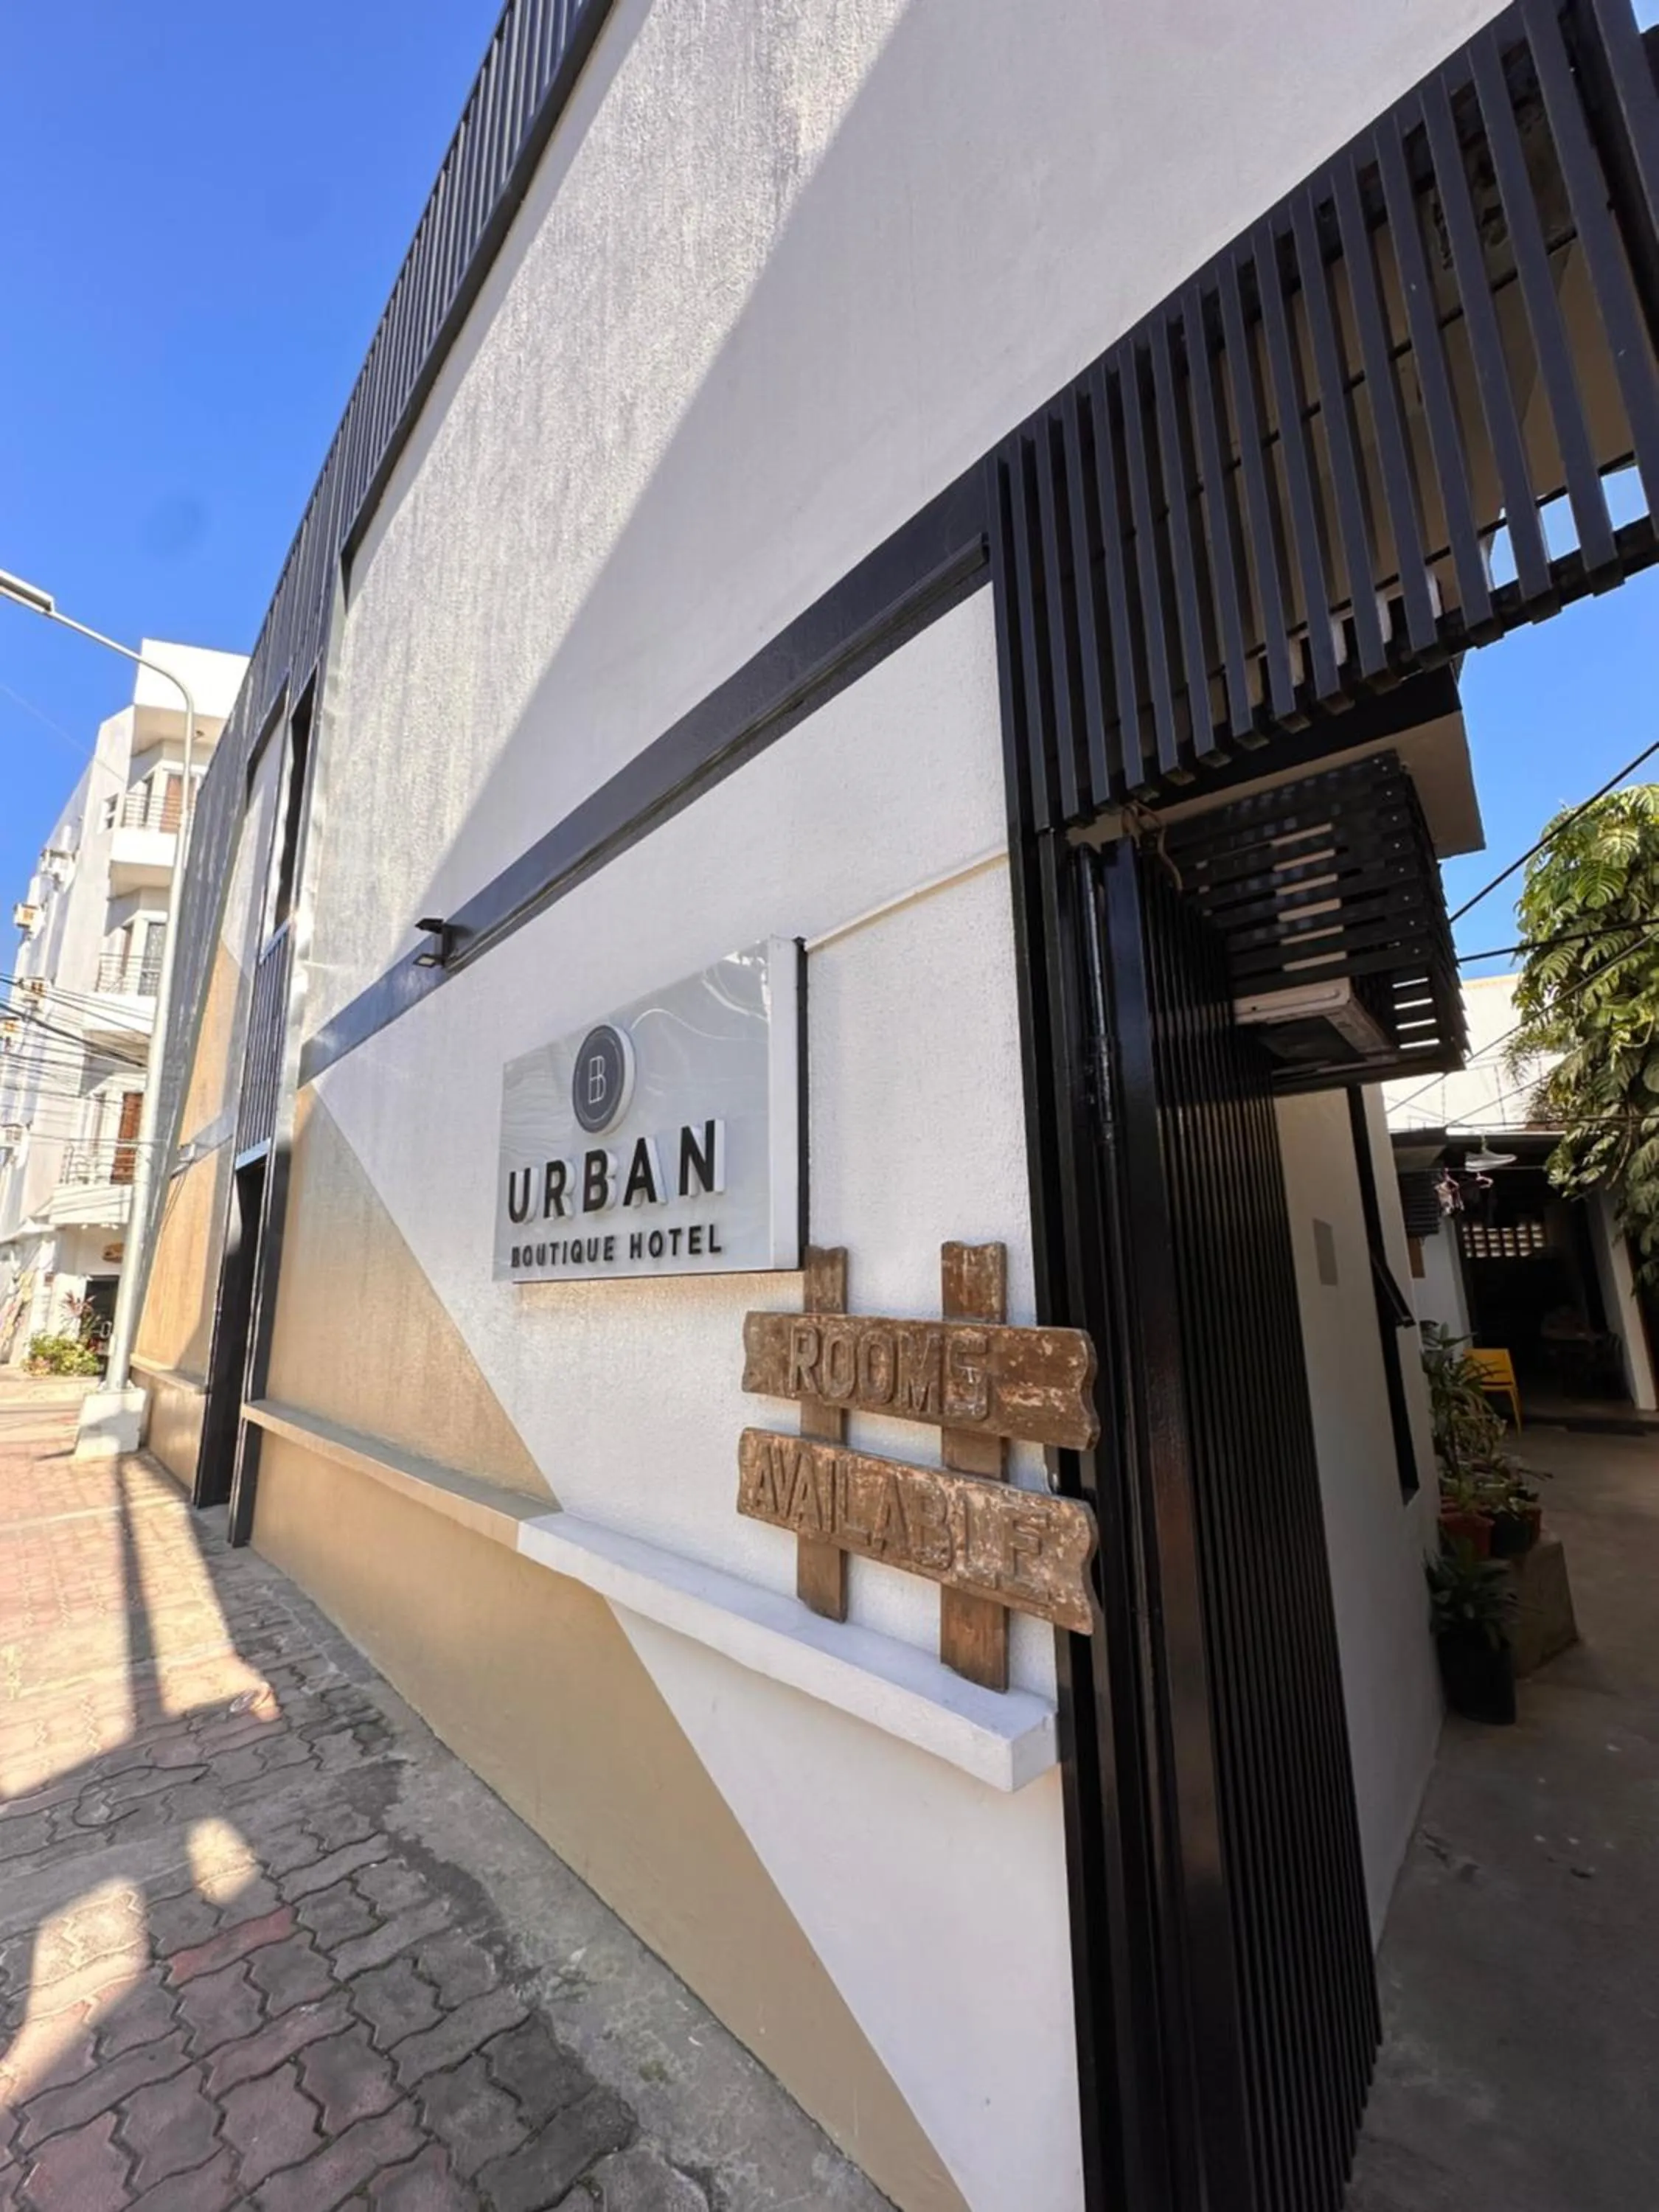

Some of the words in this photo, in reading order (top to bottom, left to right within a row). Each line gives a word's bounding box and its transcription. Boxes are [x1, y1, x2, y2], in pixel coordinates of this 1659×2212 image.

[588, 1055, 607, 1102] B
[509, 1120, 717, 1223] URBAN
[511, 1236, 615, 1268] BOUTIQUE
[630, 1224, 723, 1259] HOTEL
[789, 1326, 990, 1422] ROOMS
[753, 1445, 1051, 1606] AVAILABLE
